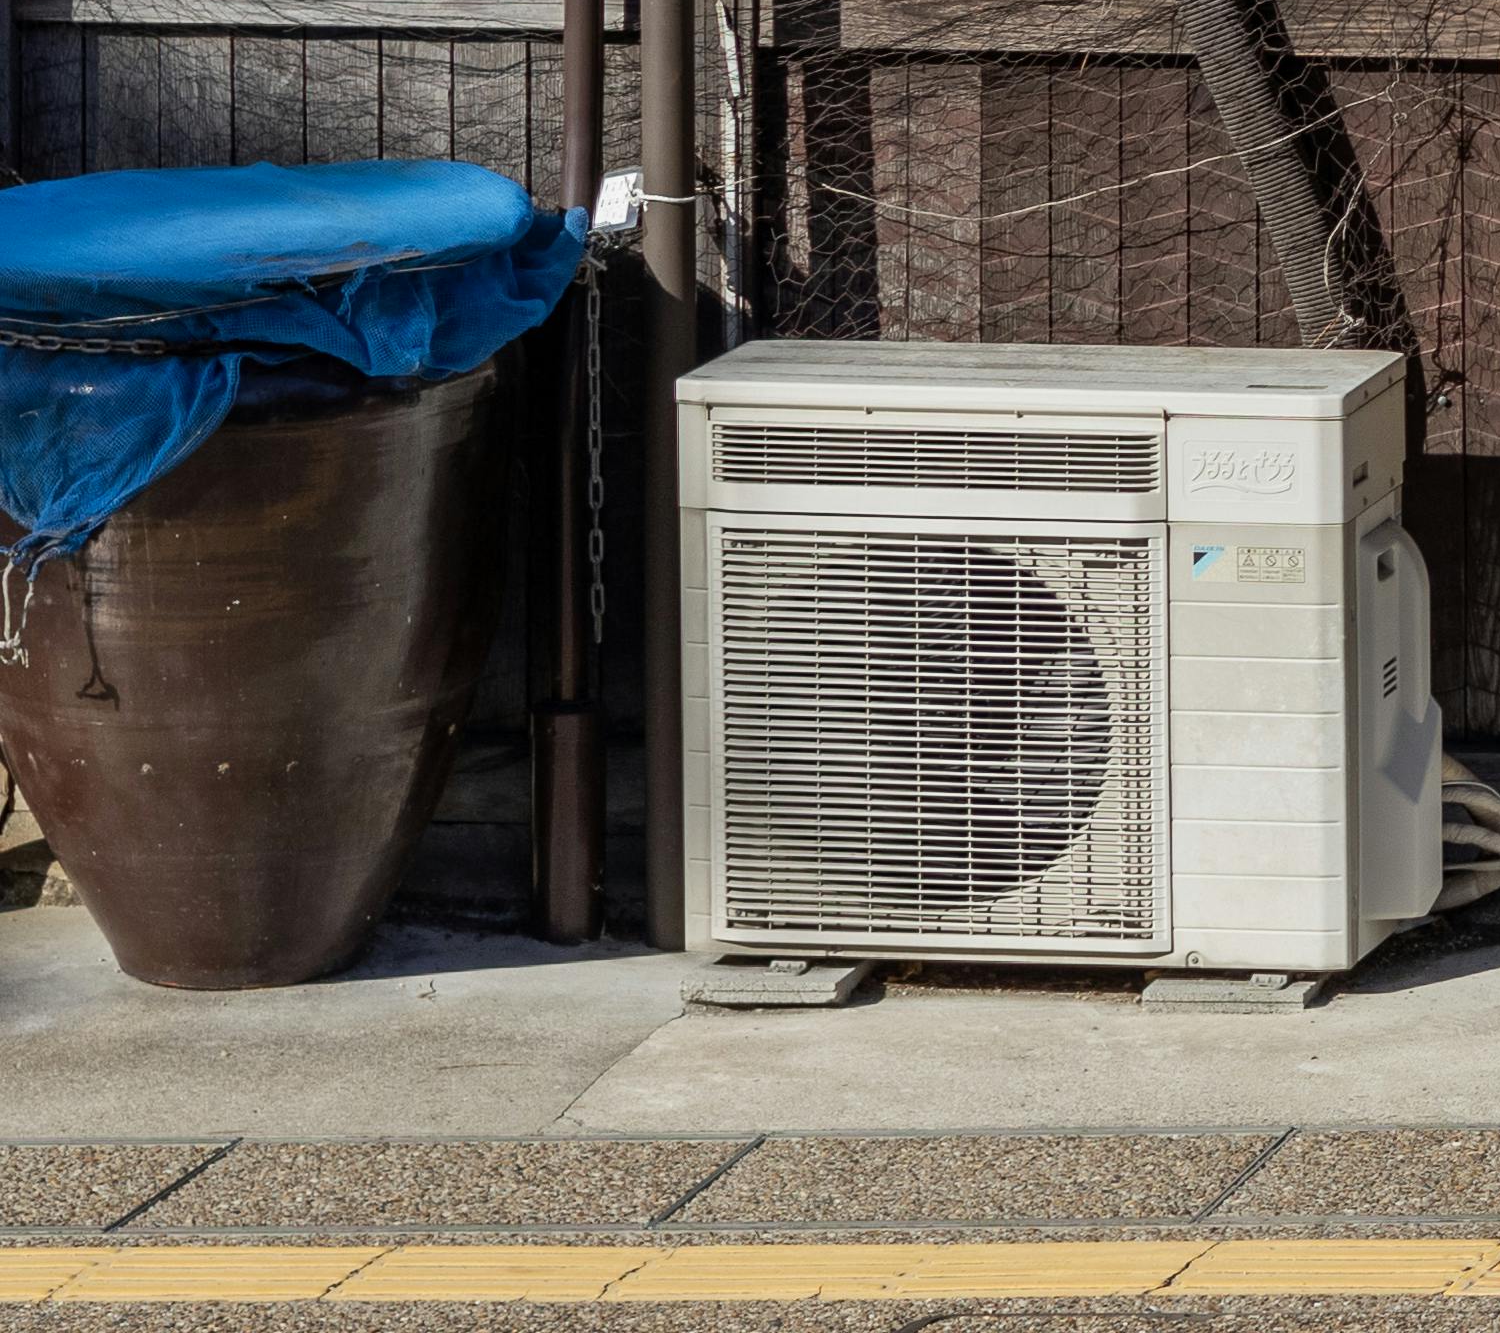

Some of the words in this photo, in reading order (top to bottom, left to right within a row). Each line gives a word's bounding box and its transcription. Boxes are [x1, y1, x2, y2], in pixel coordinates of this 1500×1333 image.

[1191, 449, 1296, 482] うるるとさらら
